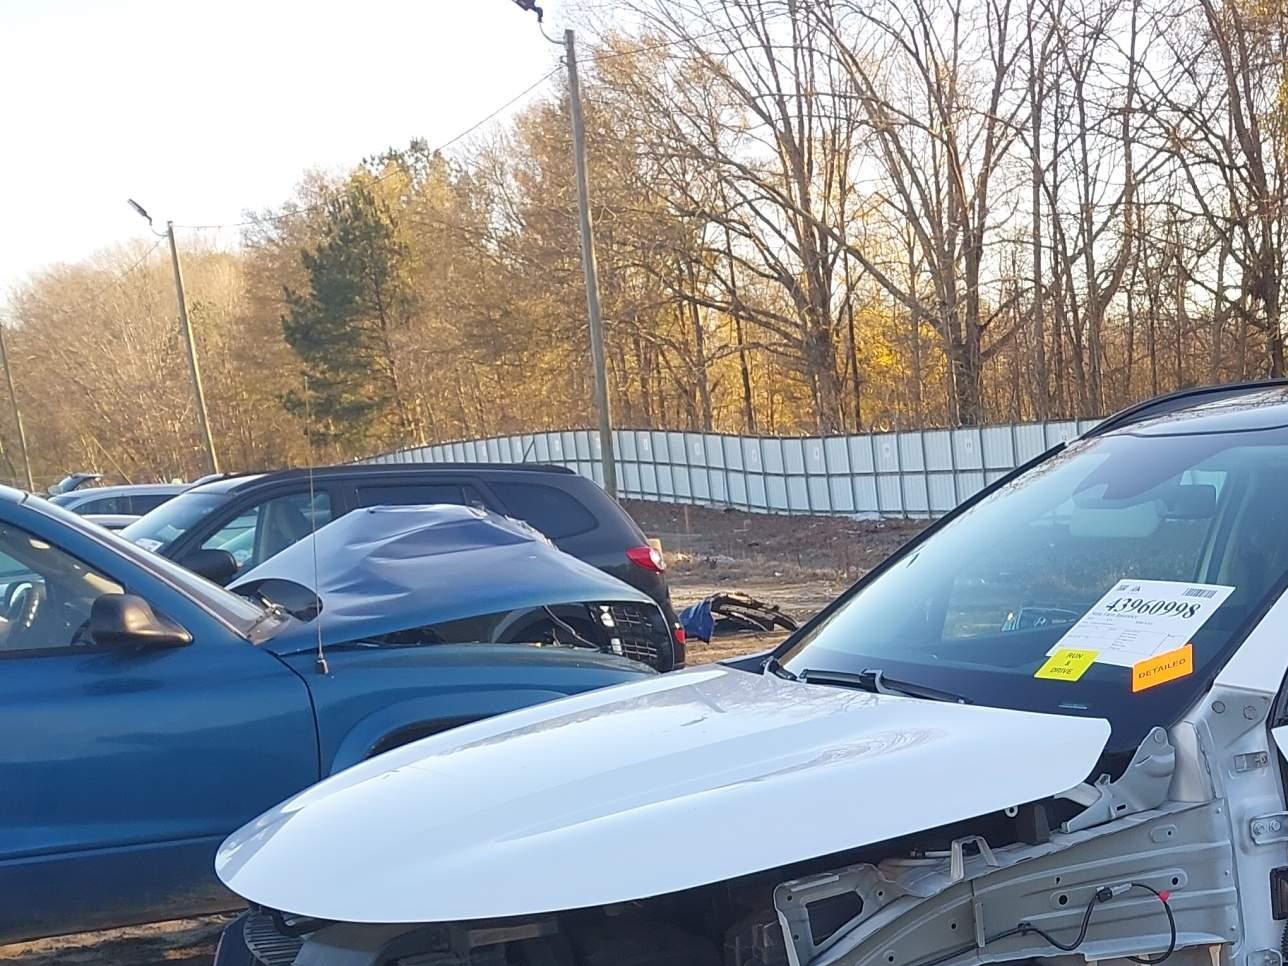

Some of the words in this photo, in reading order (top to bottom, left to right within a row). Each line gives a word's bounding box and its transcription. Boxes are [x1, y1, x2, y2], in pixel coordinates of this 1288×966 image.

[1106, 597, 1201, 619] 43960998
[1049, 667, 1073, 675] DRIVE
[1138, 658, 1186, 679] DETAILED
